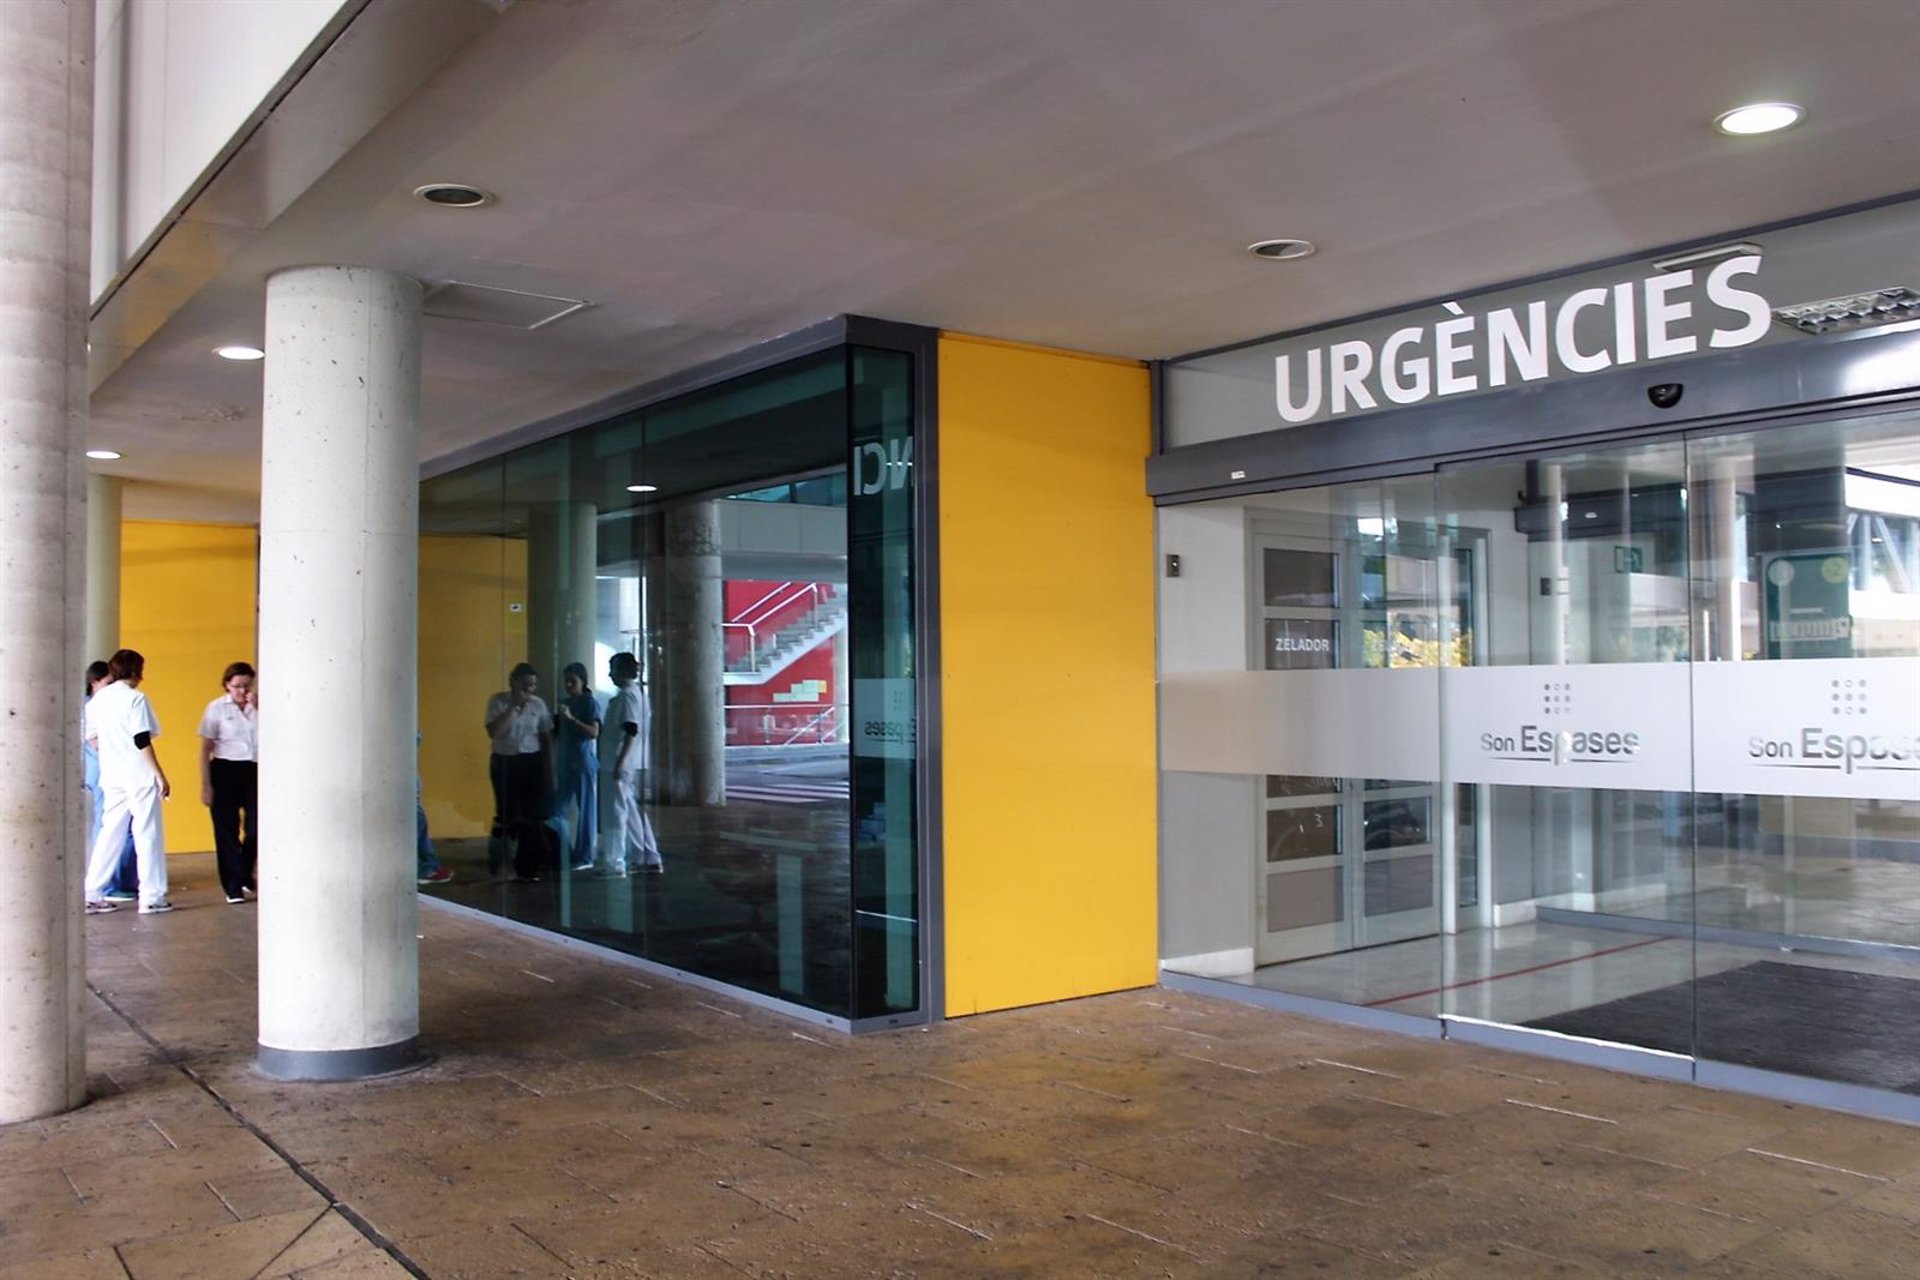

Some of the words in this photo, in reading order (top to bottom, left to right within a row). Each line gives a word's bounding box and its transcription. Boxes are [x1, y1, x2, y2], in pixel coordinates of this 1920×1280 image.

[1275, 255, 1773, 423] URGÈNCIES
[1275, 637, 1330, 652] ZELADOR
[1480, 732, 1516, 752] Son
[1748, 736, 1794, 759] Son
